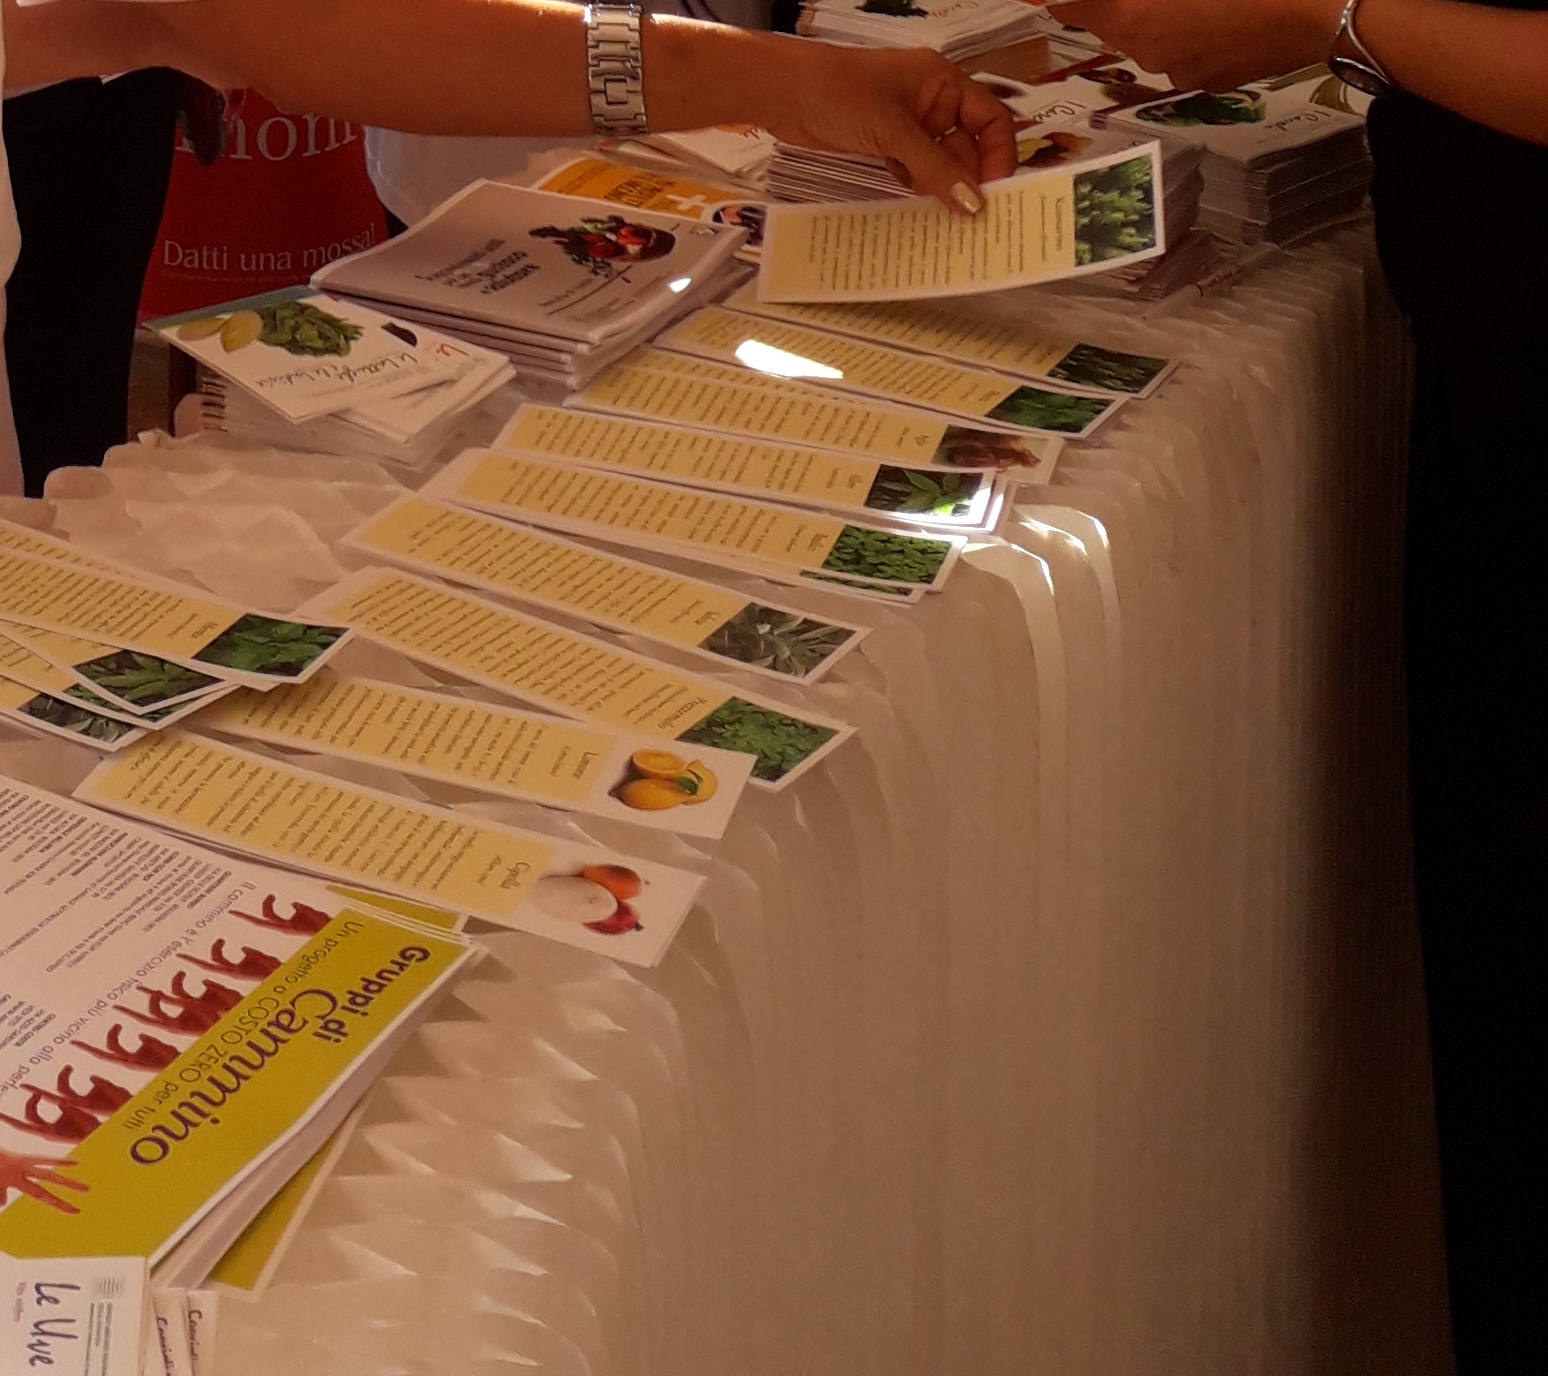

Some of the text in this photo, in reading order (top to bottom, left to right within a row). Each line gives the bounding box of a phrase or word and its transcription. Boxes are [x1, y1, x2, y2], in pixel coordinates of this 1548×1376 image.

[162, 239, 229, 272] Datti
[239, 249, 292, 272] una
[192, 888, 244, 931] cammino
[336, 919, 365, 945] Un
[286, 939, 341, 988] progetto
[228, 987, 283, 1044] COSTO
[310, 943, 433, 1046] Gruppi di
[59, 1010, 96, 1048] vicino
[25, 1040, 60, 1072] alla
[128, 986, 342, 1168] Cammino
[175, 1031, 230, 1087] ZERO
[152, 1076, 180, 1107] per
